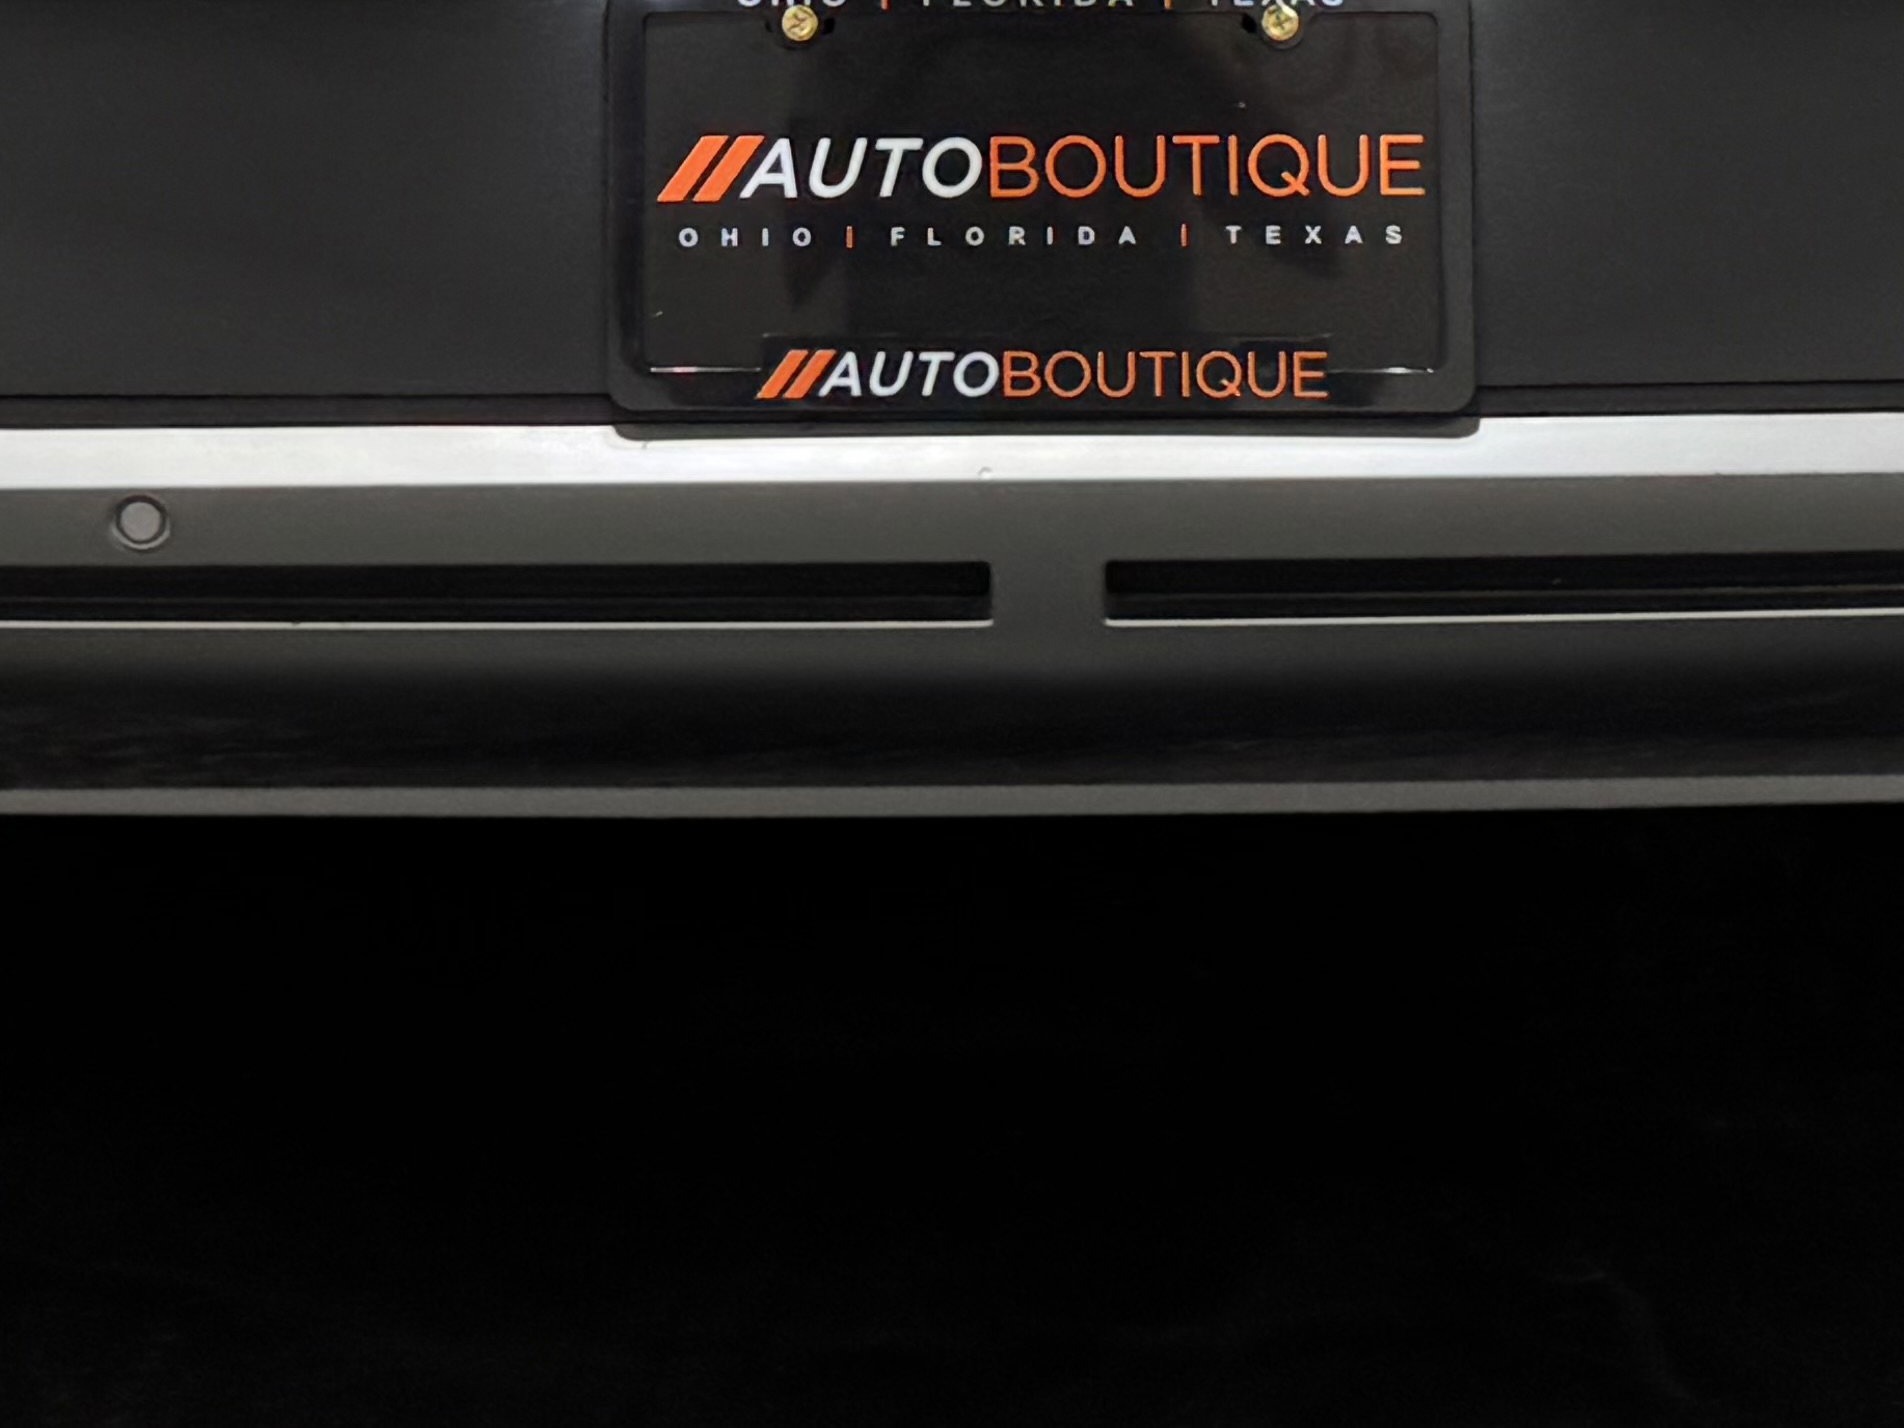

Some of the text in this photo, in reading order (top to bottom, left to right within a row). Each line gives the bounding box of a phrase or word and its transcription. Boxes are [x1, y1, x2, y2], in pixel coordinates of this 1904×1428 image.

[739, 134, 1425, 198] AUTOBOUTIQUE
[678, 225, 1404, 247] OHIO FLORIDA TEXAS
[824, 349, 1329, 399] AUTOBOUTIQUE
